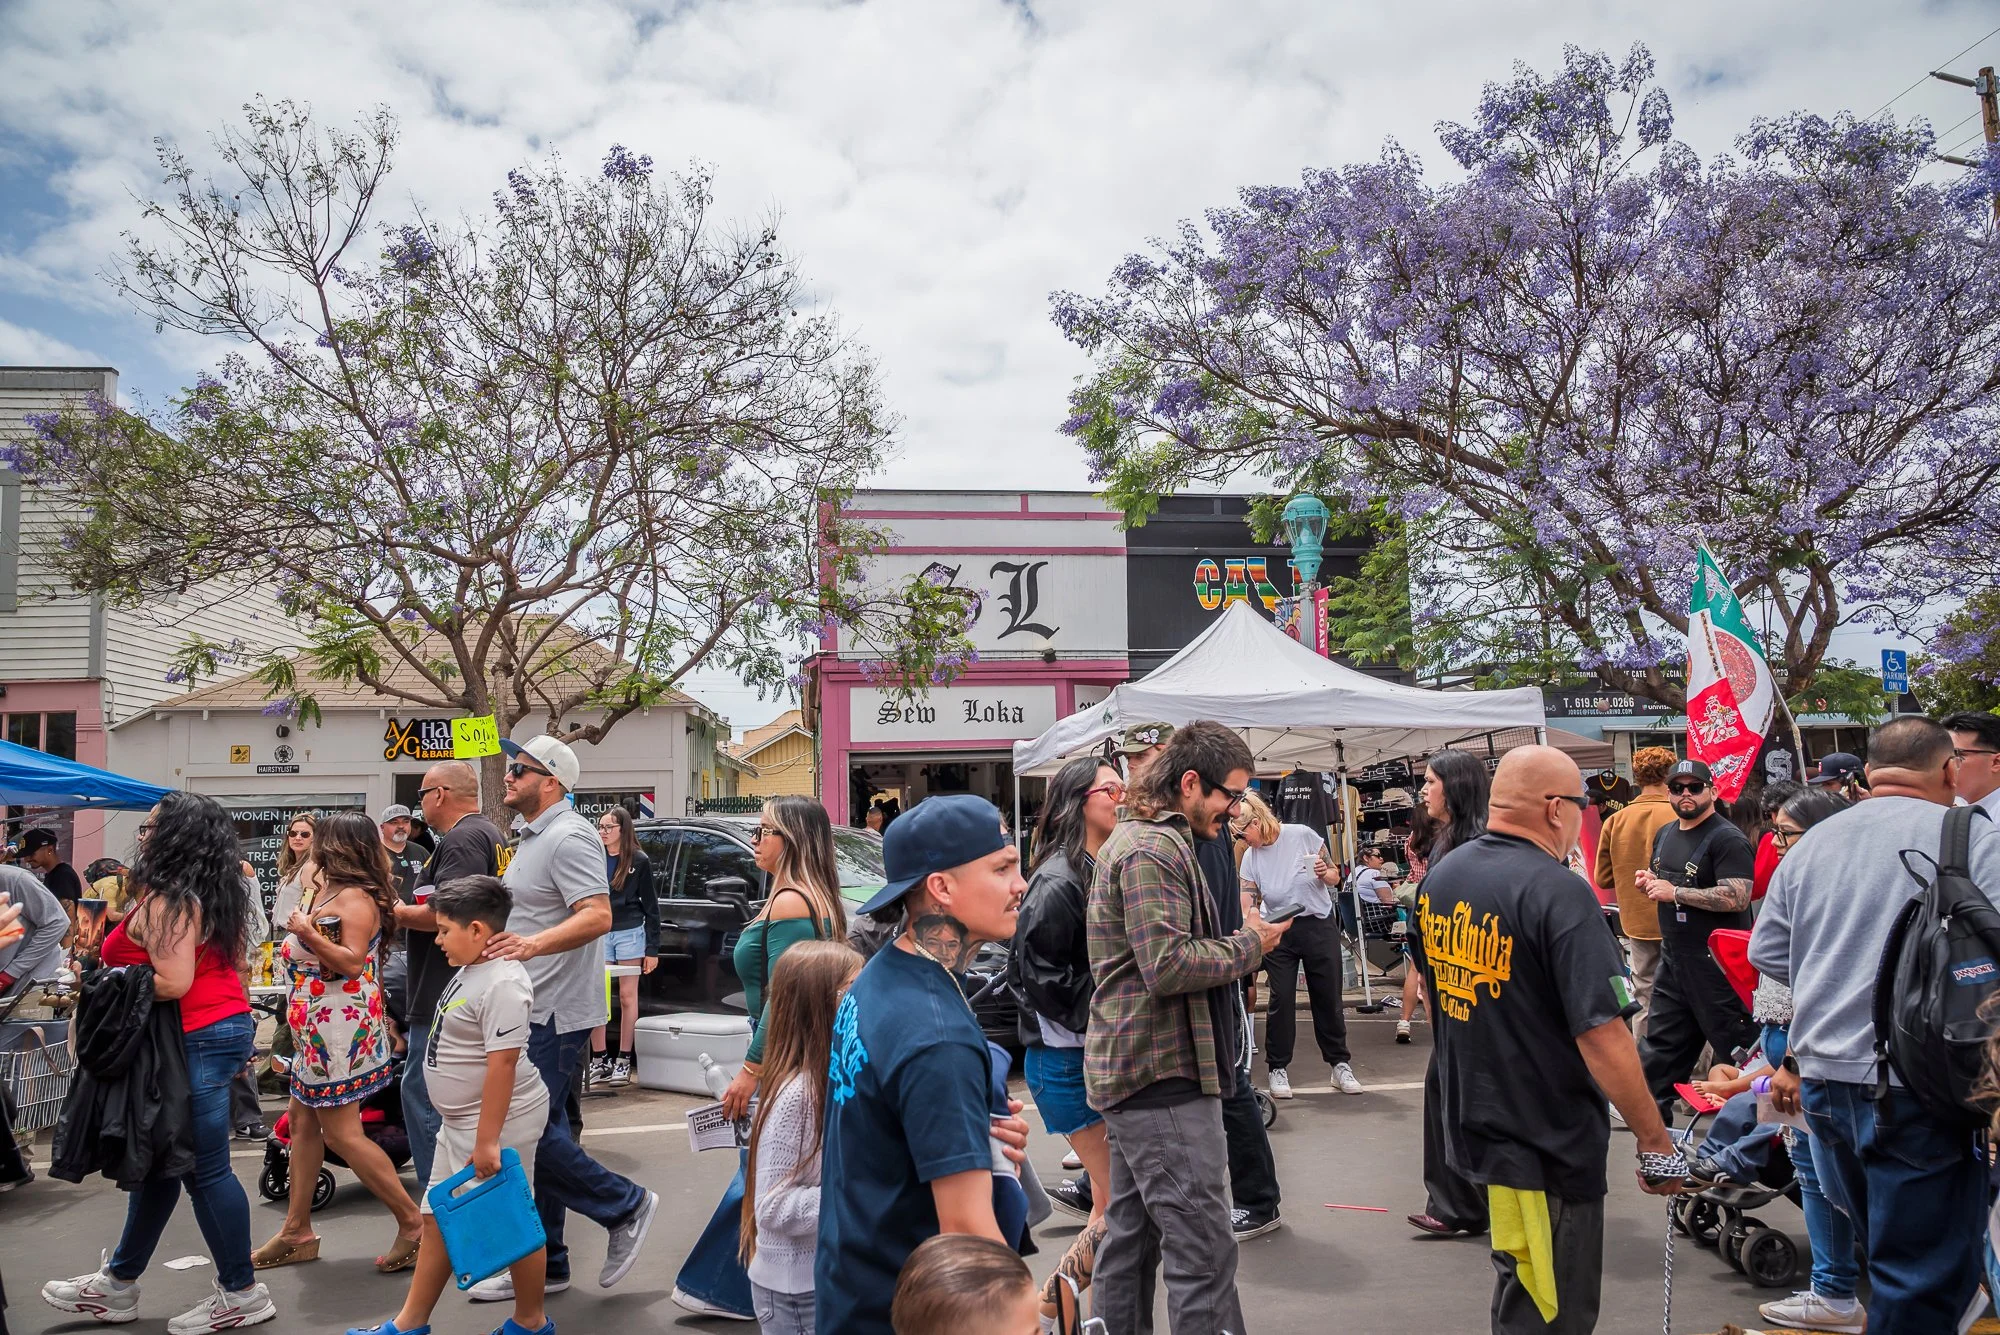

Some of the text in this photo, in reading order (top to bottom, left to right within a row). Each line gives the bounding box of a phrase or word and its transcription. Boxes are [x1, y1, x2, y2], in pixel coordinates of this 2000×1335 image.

[1318, 597, 1326, 650] LOGAN
[1883, 671, 1907, 681] PARKING
[1888, 681, 1903, 691] ONLY
[1563, 697, 1635, 708] T. 619.6.0266
[877, 699, 1025, 725] Sew Loka
[258, 765, 292, 773] HAIRSTYLIST
[231, 811, 279, 821] WOMEN
[1448, 997, 1470, 1022] Club
[695, 1114, 710, 1122] THE
[697, 1119, 731, 1132] CHRIST
